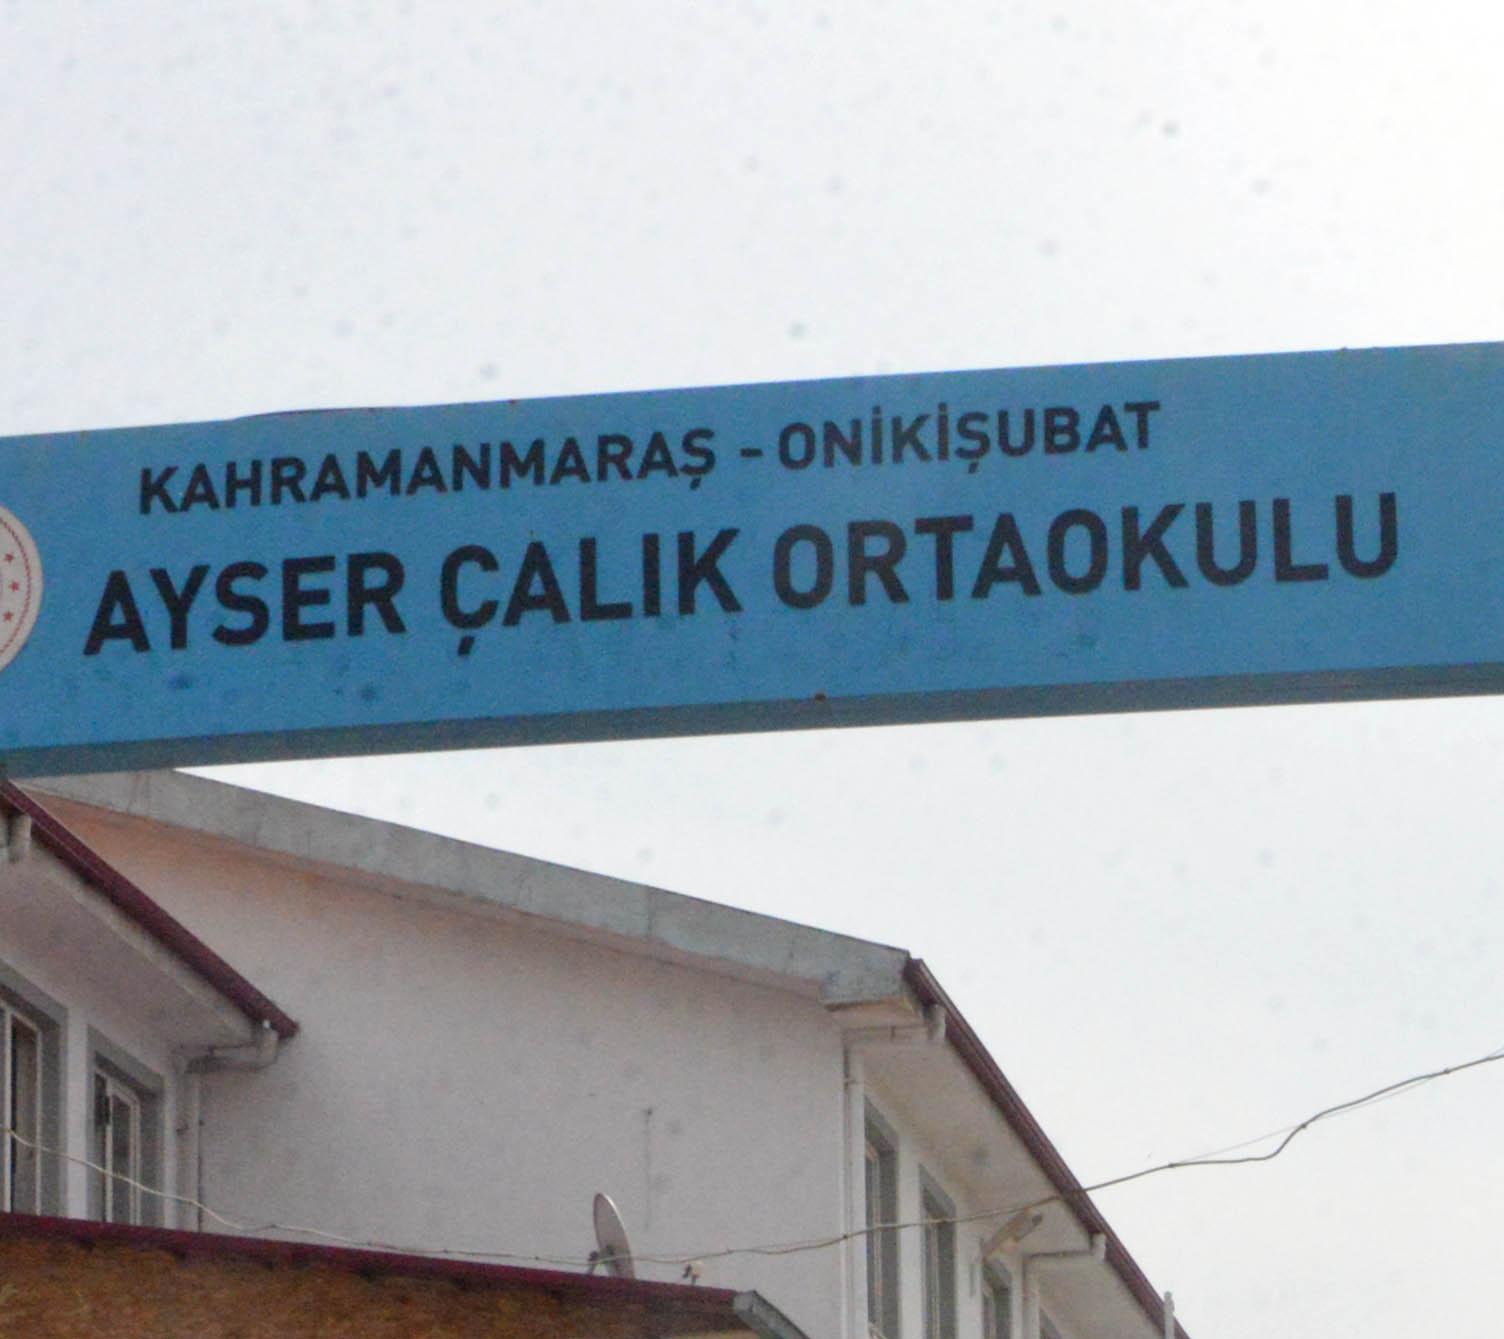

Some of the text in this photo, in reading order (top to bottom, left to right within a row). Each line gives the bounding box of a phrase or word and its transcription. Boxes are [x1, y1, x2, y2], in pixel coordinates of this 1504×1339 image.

[138, 401, 1161, 515] KAHRAMANMARAŞ - ONİKİŞUBAT
[82, 491, 1398, 658] AYSER ÇALIK ORTAOKULU
